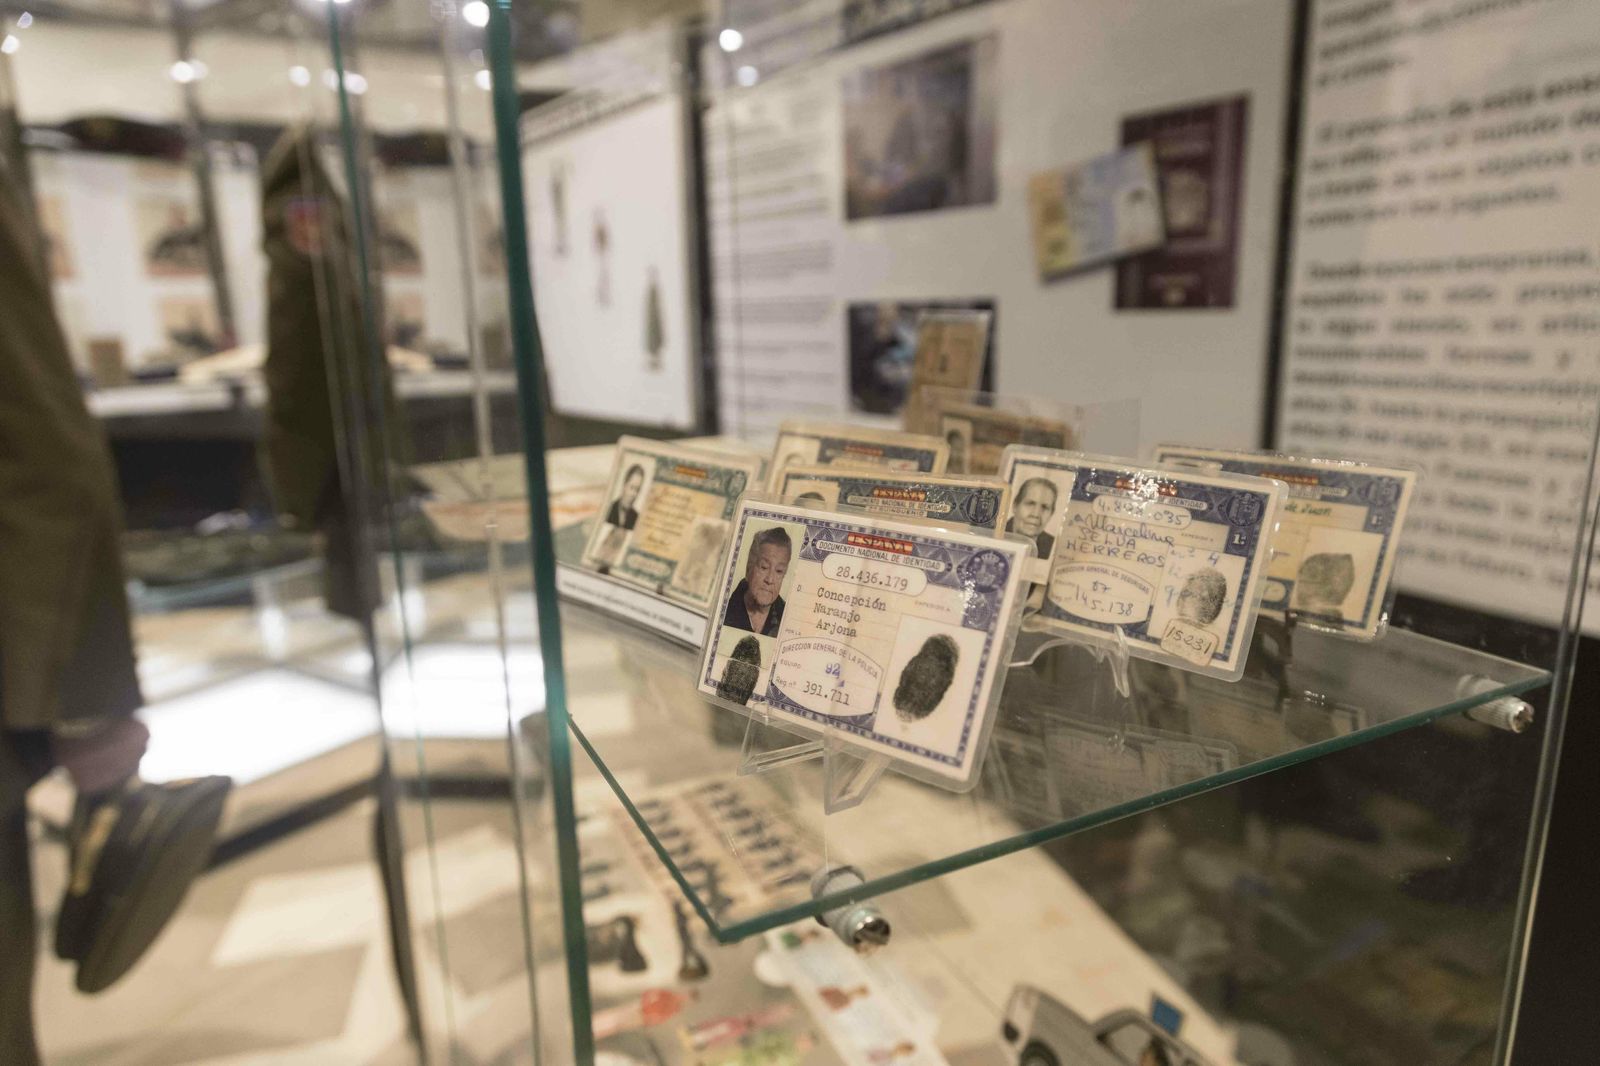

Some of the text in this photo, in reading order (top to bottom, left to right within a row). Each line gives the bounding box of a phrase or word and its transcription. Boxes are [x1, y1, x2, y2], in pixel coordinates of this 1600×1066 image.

[852, 534, 907, 552] ESPAÑA
[818, 541, 942, 571] DOCUMENTO NACIONAL DE IDENTIDAD
[836, 565, 909, 591] 28.436.179
[816, 587, 887, 612] Concepción
[813, 602, 861, 623] Naranjo
[815, 618, 858, 638] Arjona
[781, 642, 878, 680] DIRECCION GENERAL DE LA POLICIA
[802, 681, 850, 706] 391.711
